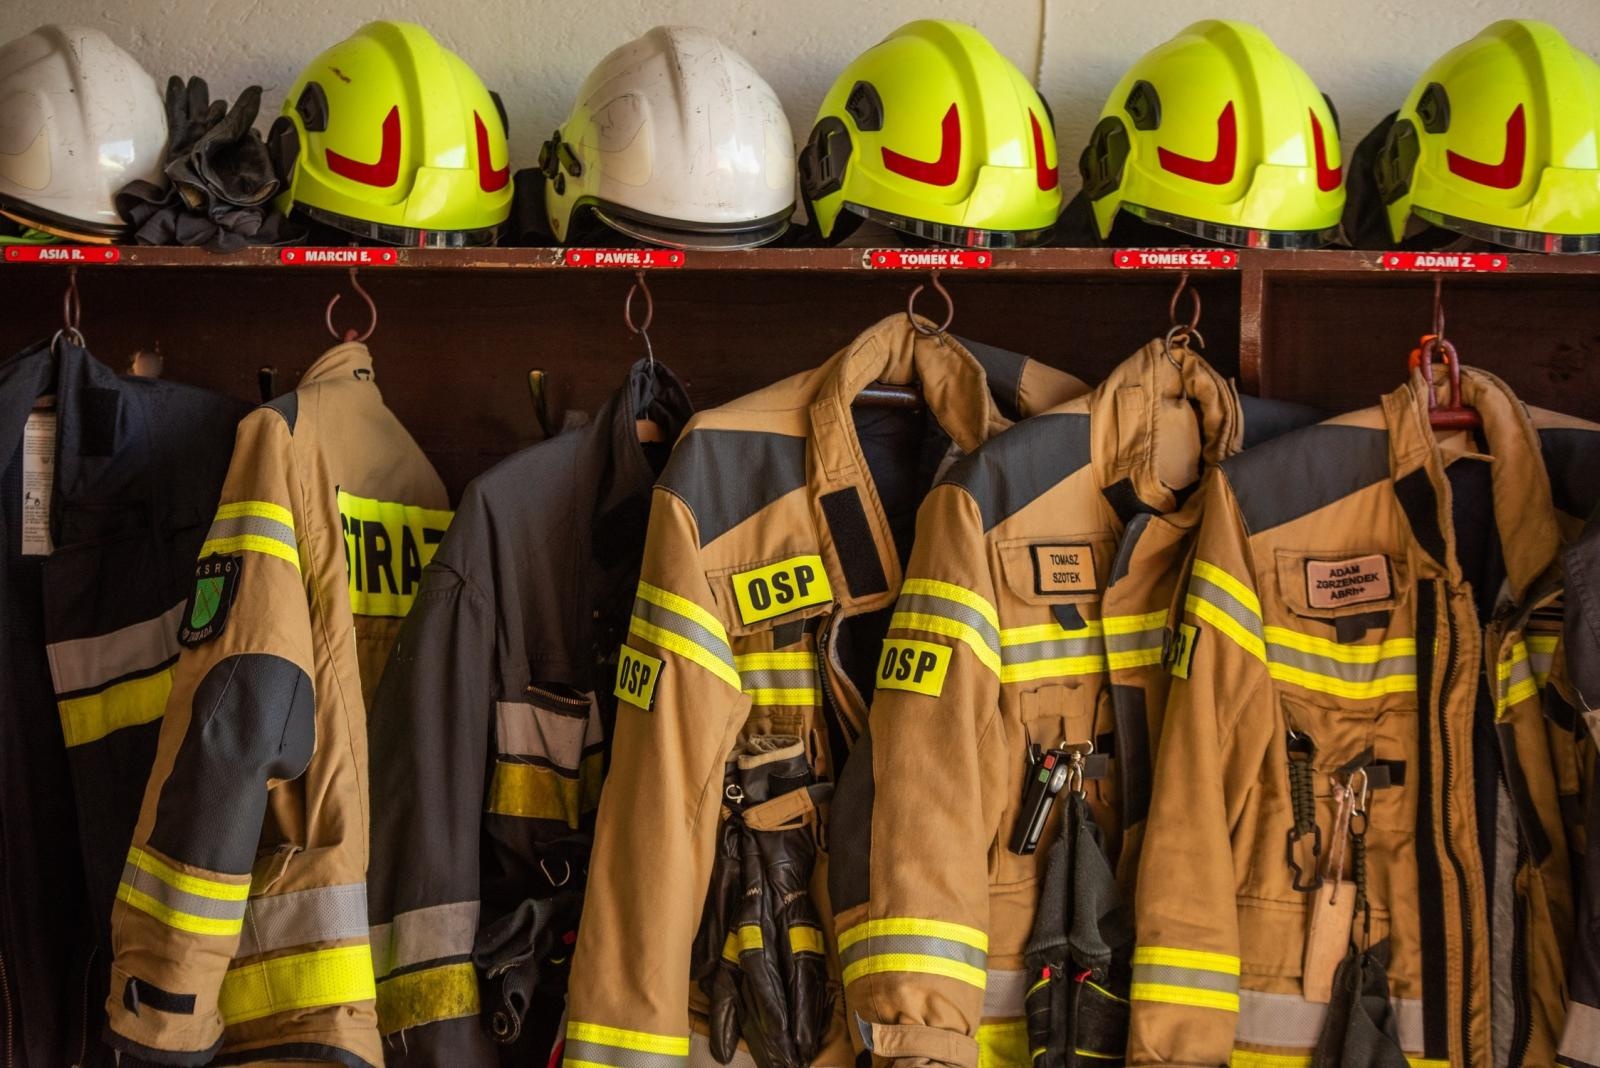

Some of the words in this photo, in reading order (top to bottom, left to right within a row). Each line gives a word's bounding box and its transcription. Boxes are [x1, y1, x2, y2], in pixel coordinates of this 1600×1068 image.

[39, 248, 69, 260] ASIA
[72, 248, 85, 260] R.
[305, 250, 358, 262] MARCIN
[360, 250, 372, 262] E.
[595, 252, 641, 264] PAWEŁ
[642, 252, 654, 264] J.
[899, 253, 948, 265] TOMEK
[949, 253, 964, 265] K.
[1139, 253, 1188, 265] TOMEK
[1190, 253, 1212, 265] SZ.
[1414, 255, 1459, 267] ADAM
[1461, 256, 1476, 268] Z.
[1050, 554, 1080, 566] TOMASZ
[1329, 564, 1361, 578] ADAM
[1052, 572, 1081, 584] SZOTEK
[1316, 572, 1380, 590] ZGRZENDEK
[748, 564, 815, 611] OSP
[881, 646, 938, 684] OSP
[620, 655, 651, 697] OSP
